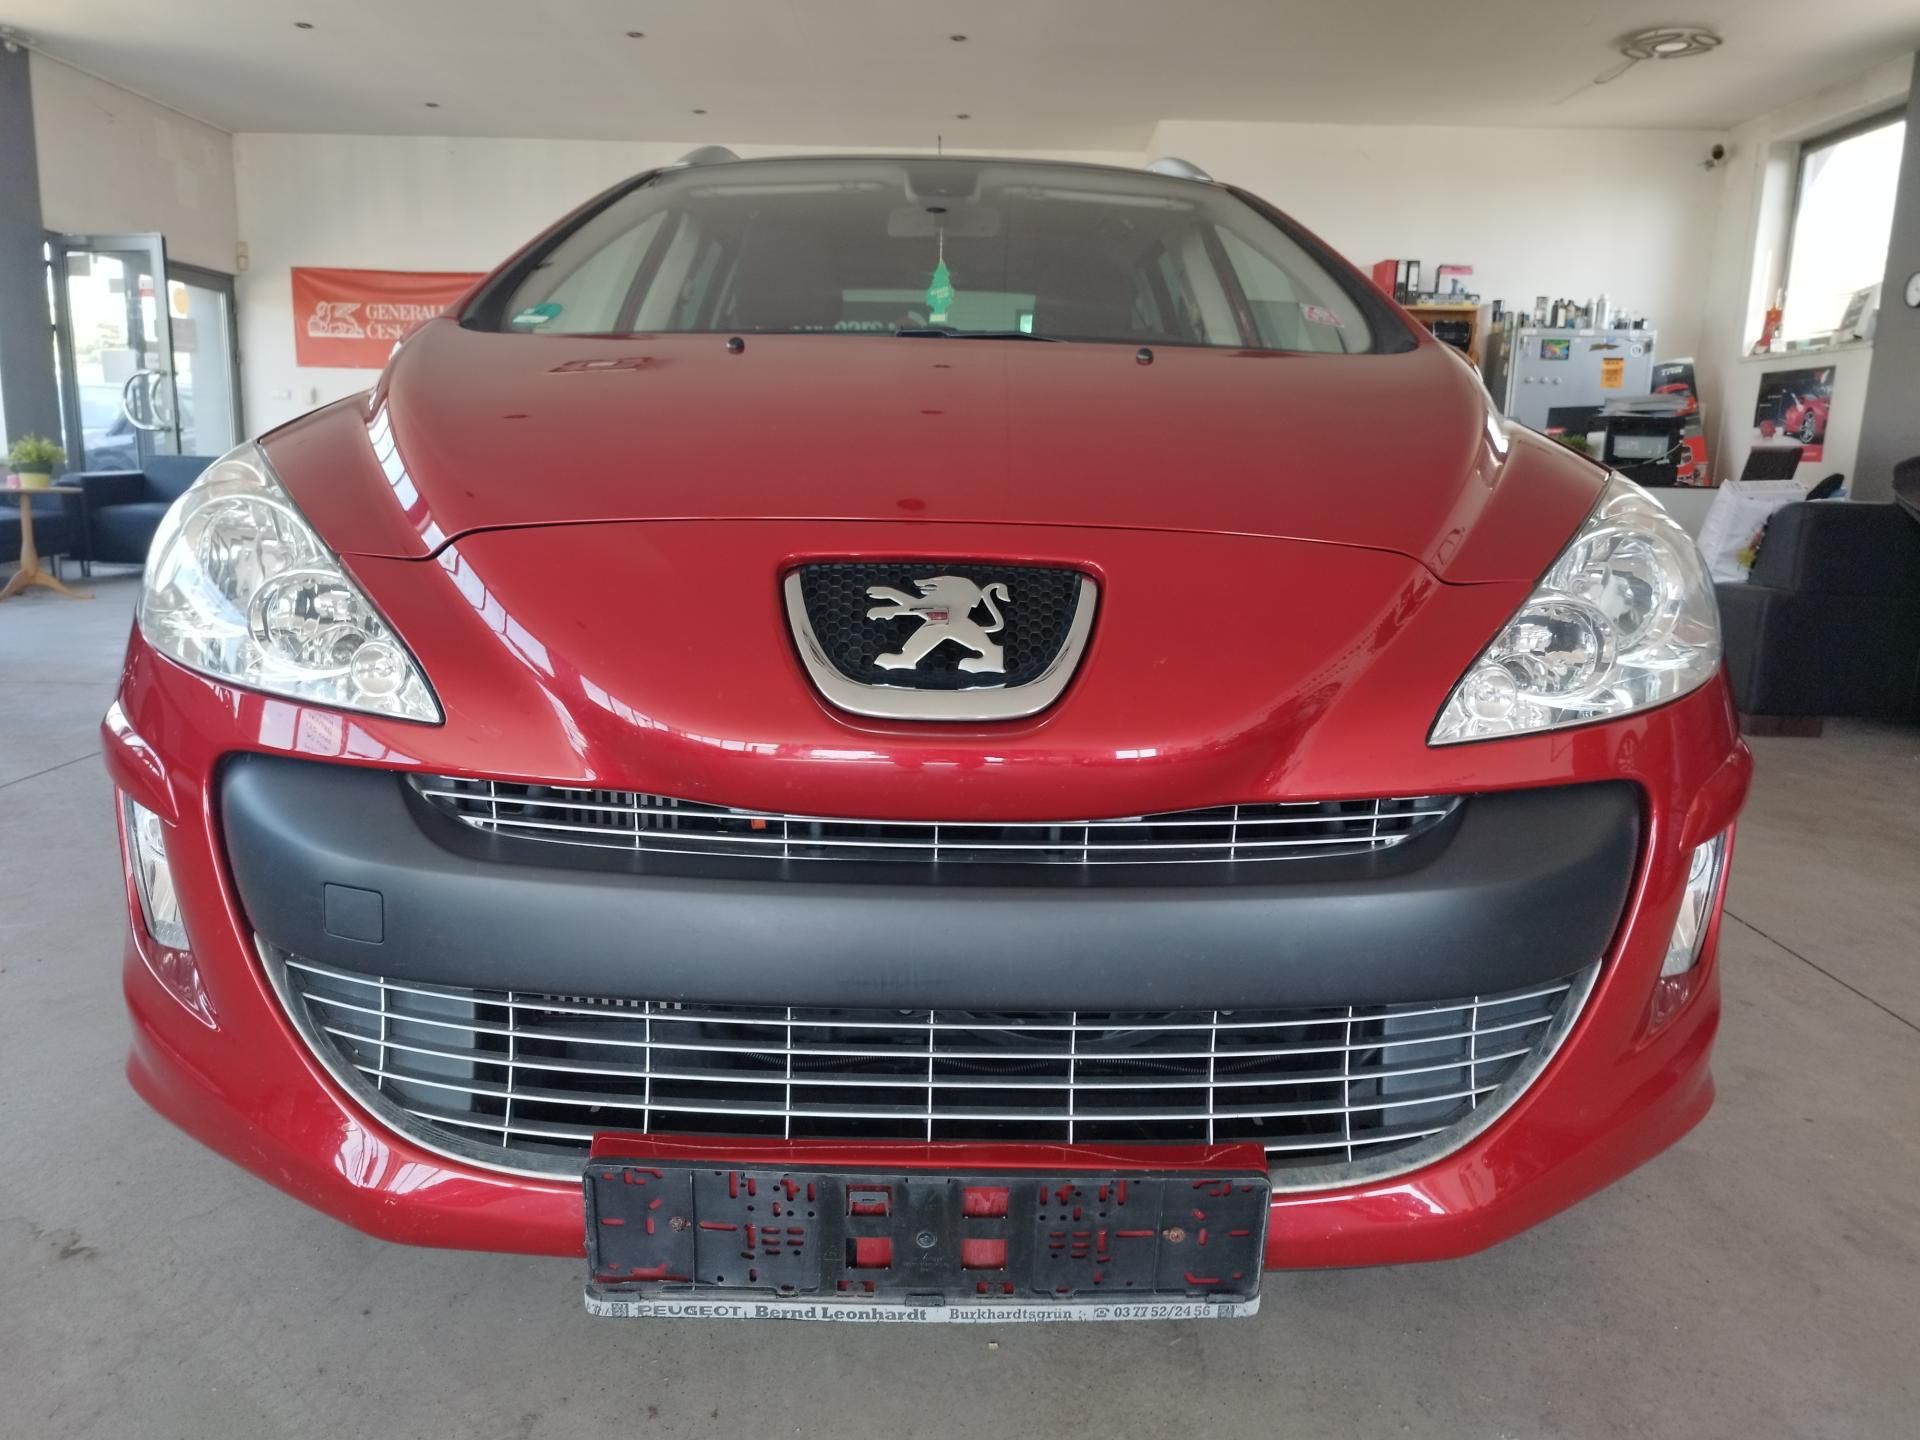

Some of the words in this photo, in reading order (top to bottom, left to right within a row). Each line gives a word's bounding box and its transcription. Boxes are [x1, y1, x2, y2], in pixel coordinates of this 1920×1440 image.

[366, 320, 407, 340] ČESK
[637, 1305, 742, 1317] PEUGEOT
[755, 1305, 816, 1319] Bernd
[821, 1306, 927, 1322] Leonhardt
[949, 1307, 1073, 1321] Burkhardtsgrün
